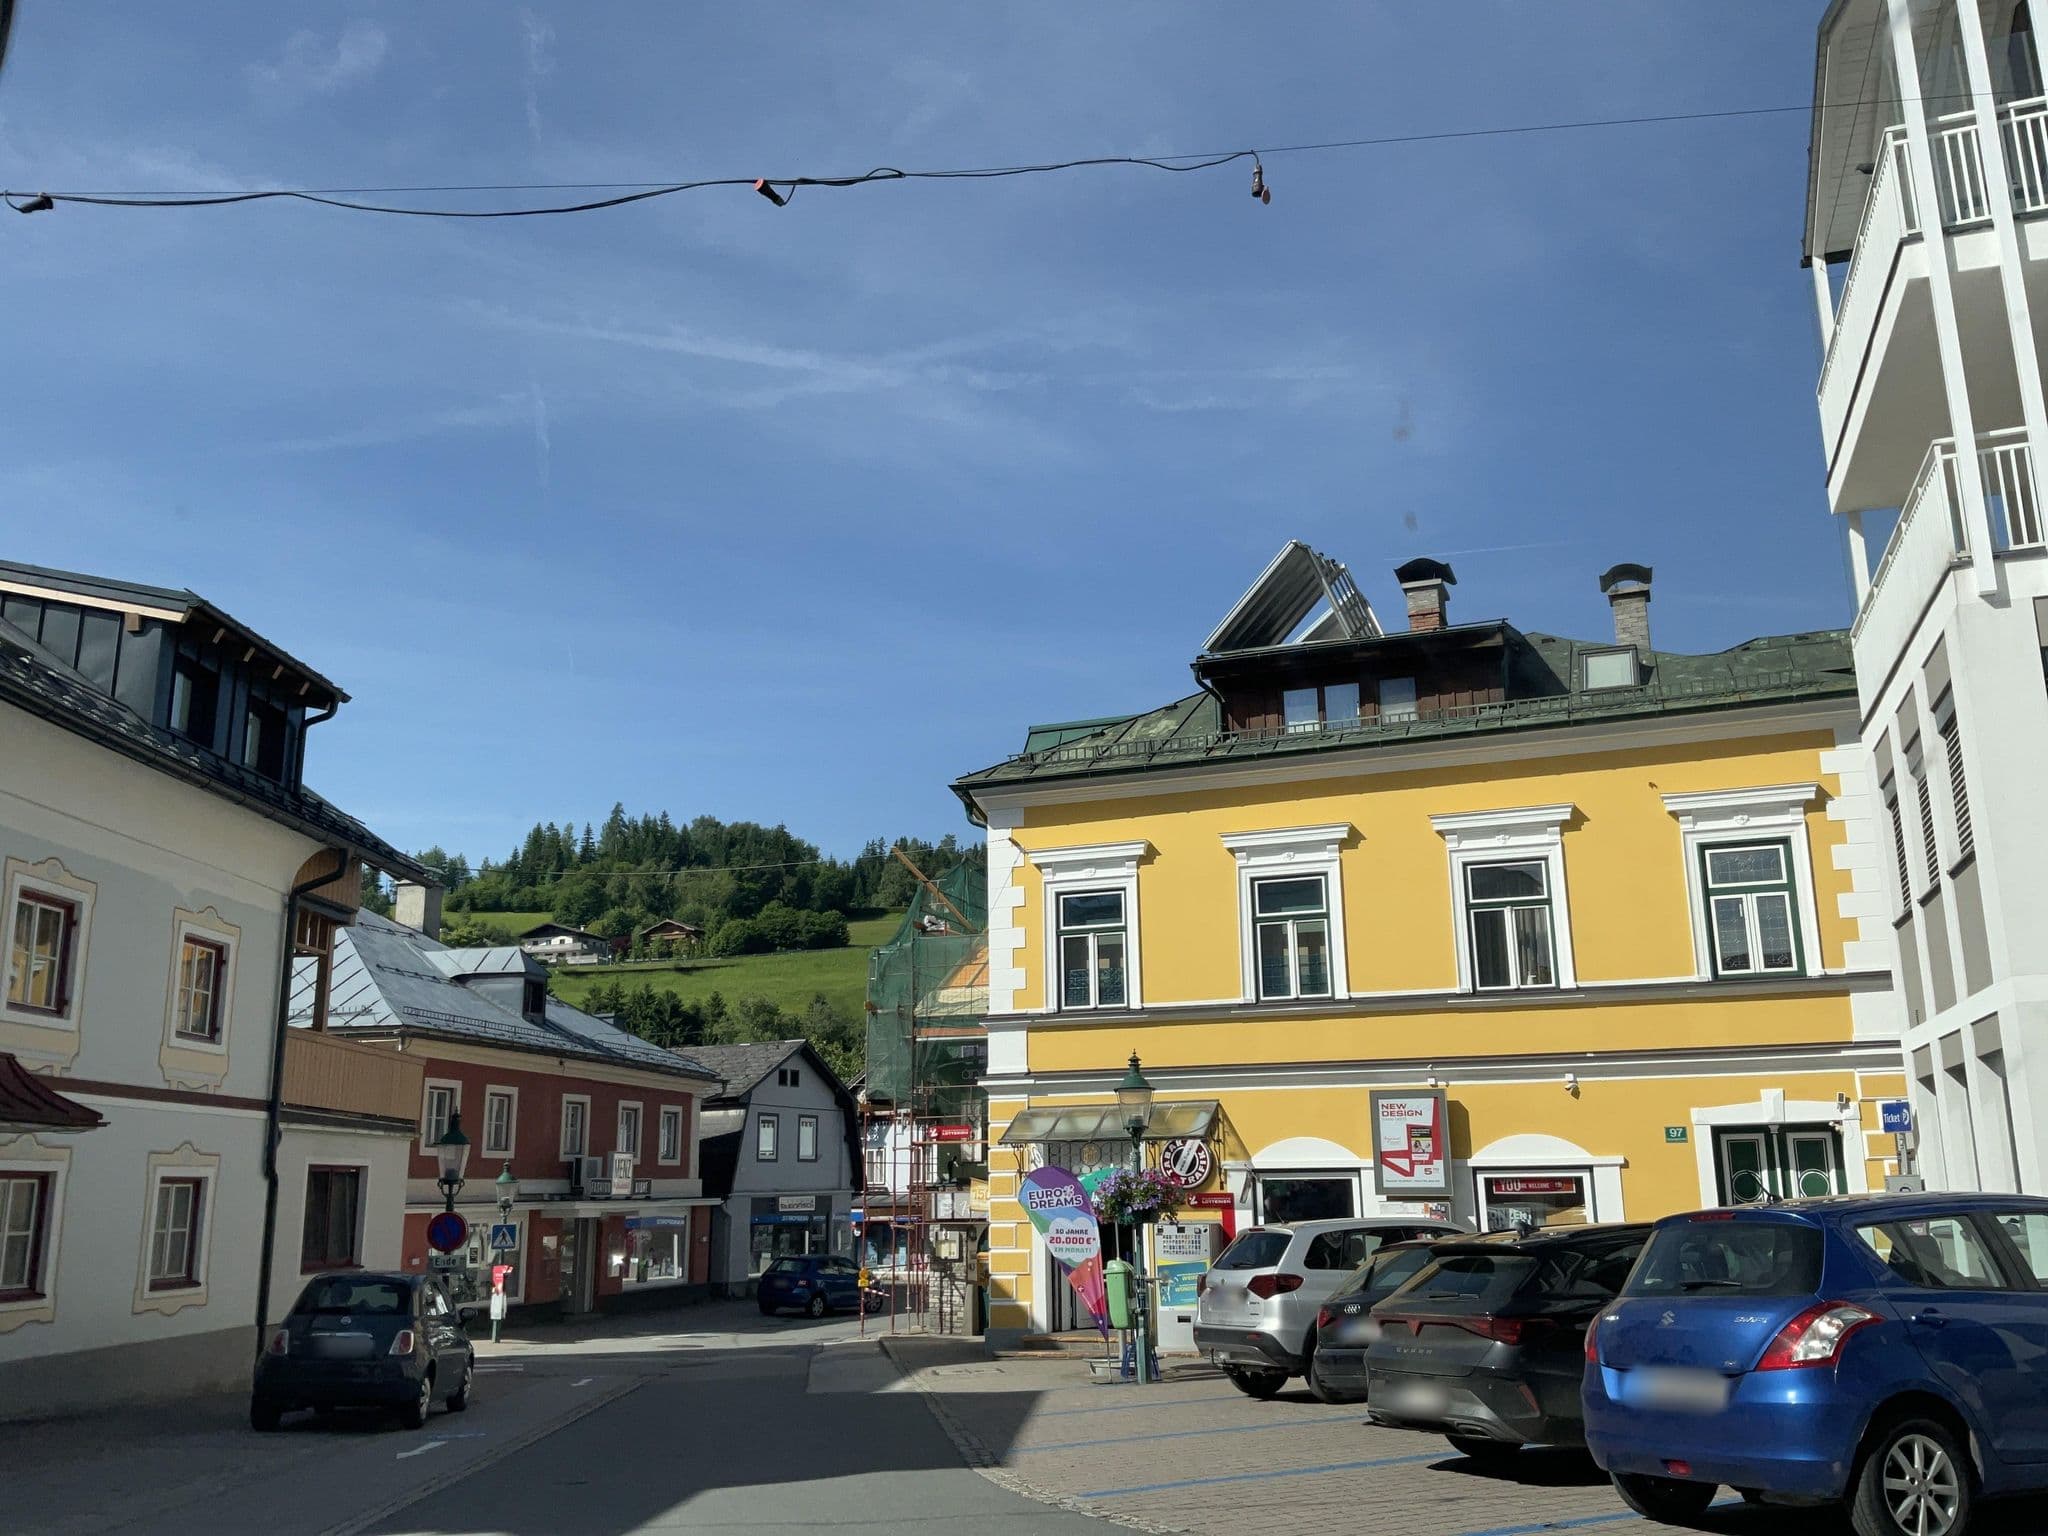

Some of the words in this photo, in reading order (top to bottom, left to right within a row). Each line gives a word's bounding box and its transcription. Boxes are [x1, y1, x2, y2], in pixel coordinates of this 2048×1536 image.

[1883, 1112, 1901, 1124] Ticket
[1669, 1128, 1683, 1137] 97
[1028, 1188, 1063, 1201] EURO
[1030, 1195, 1083, 1210] DREAMS
[1049, 1236, 1085, 1245] 20.000
